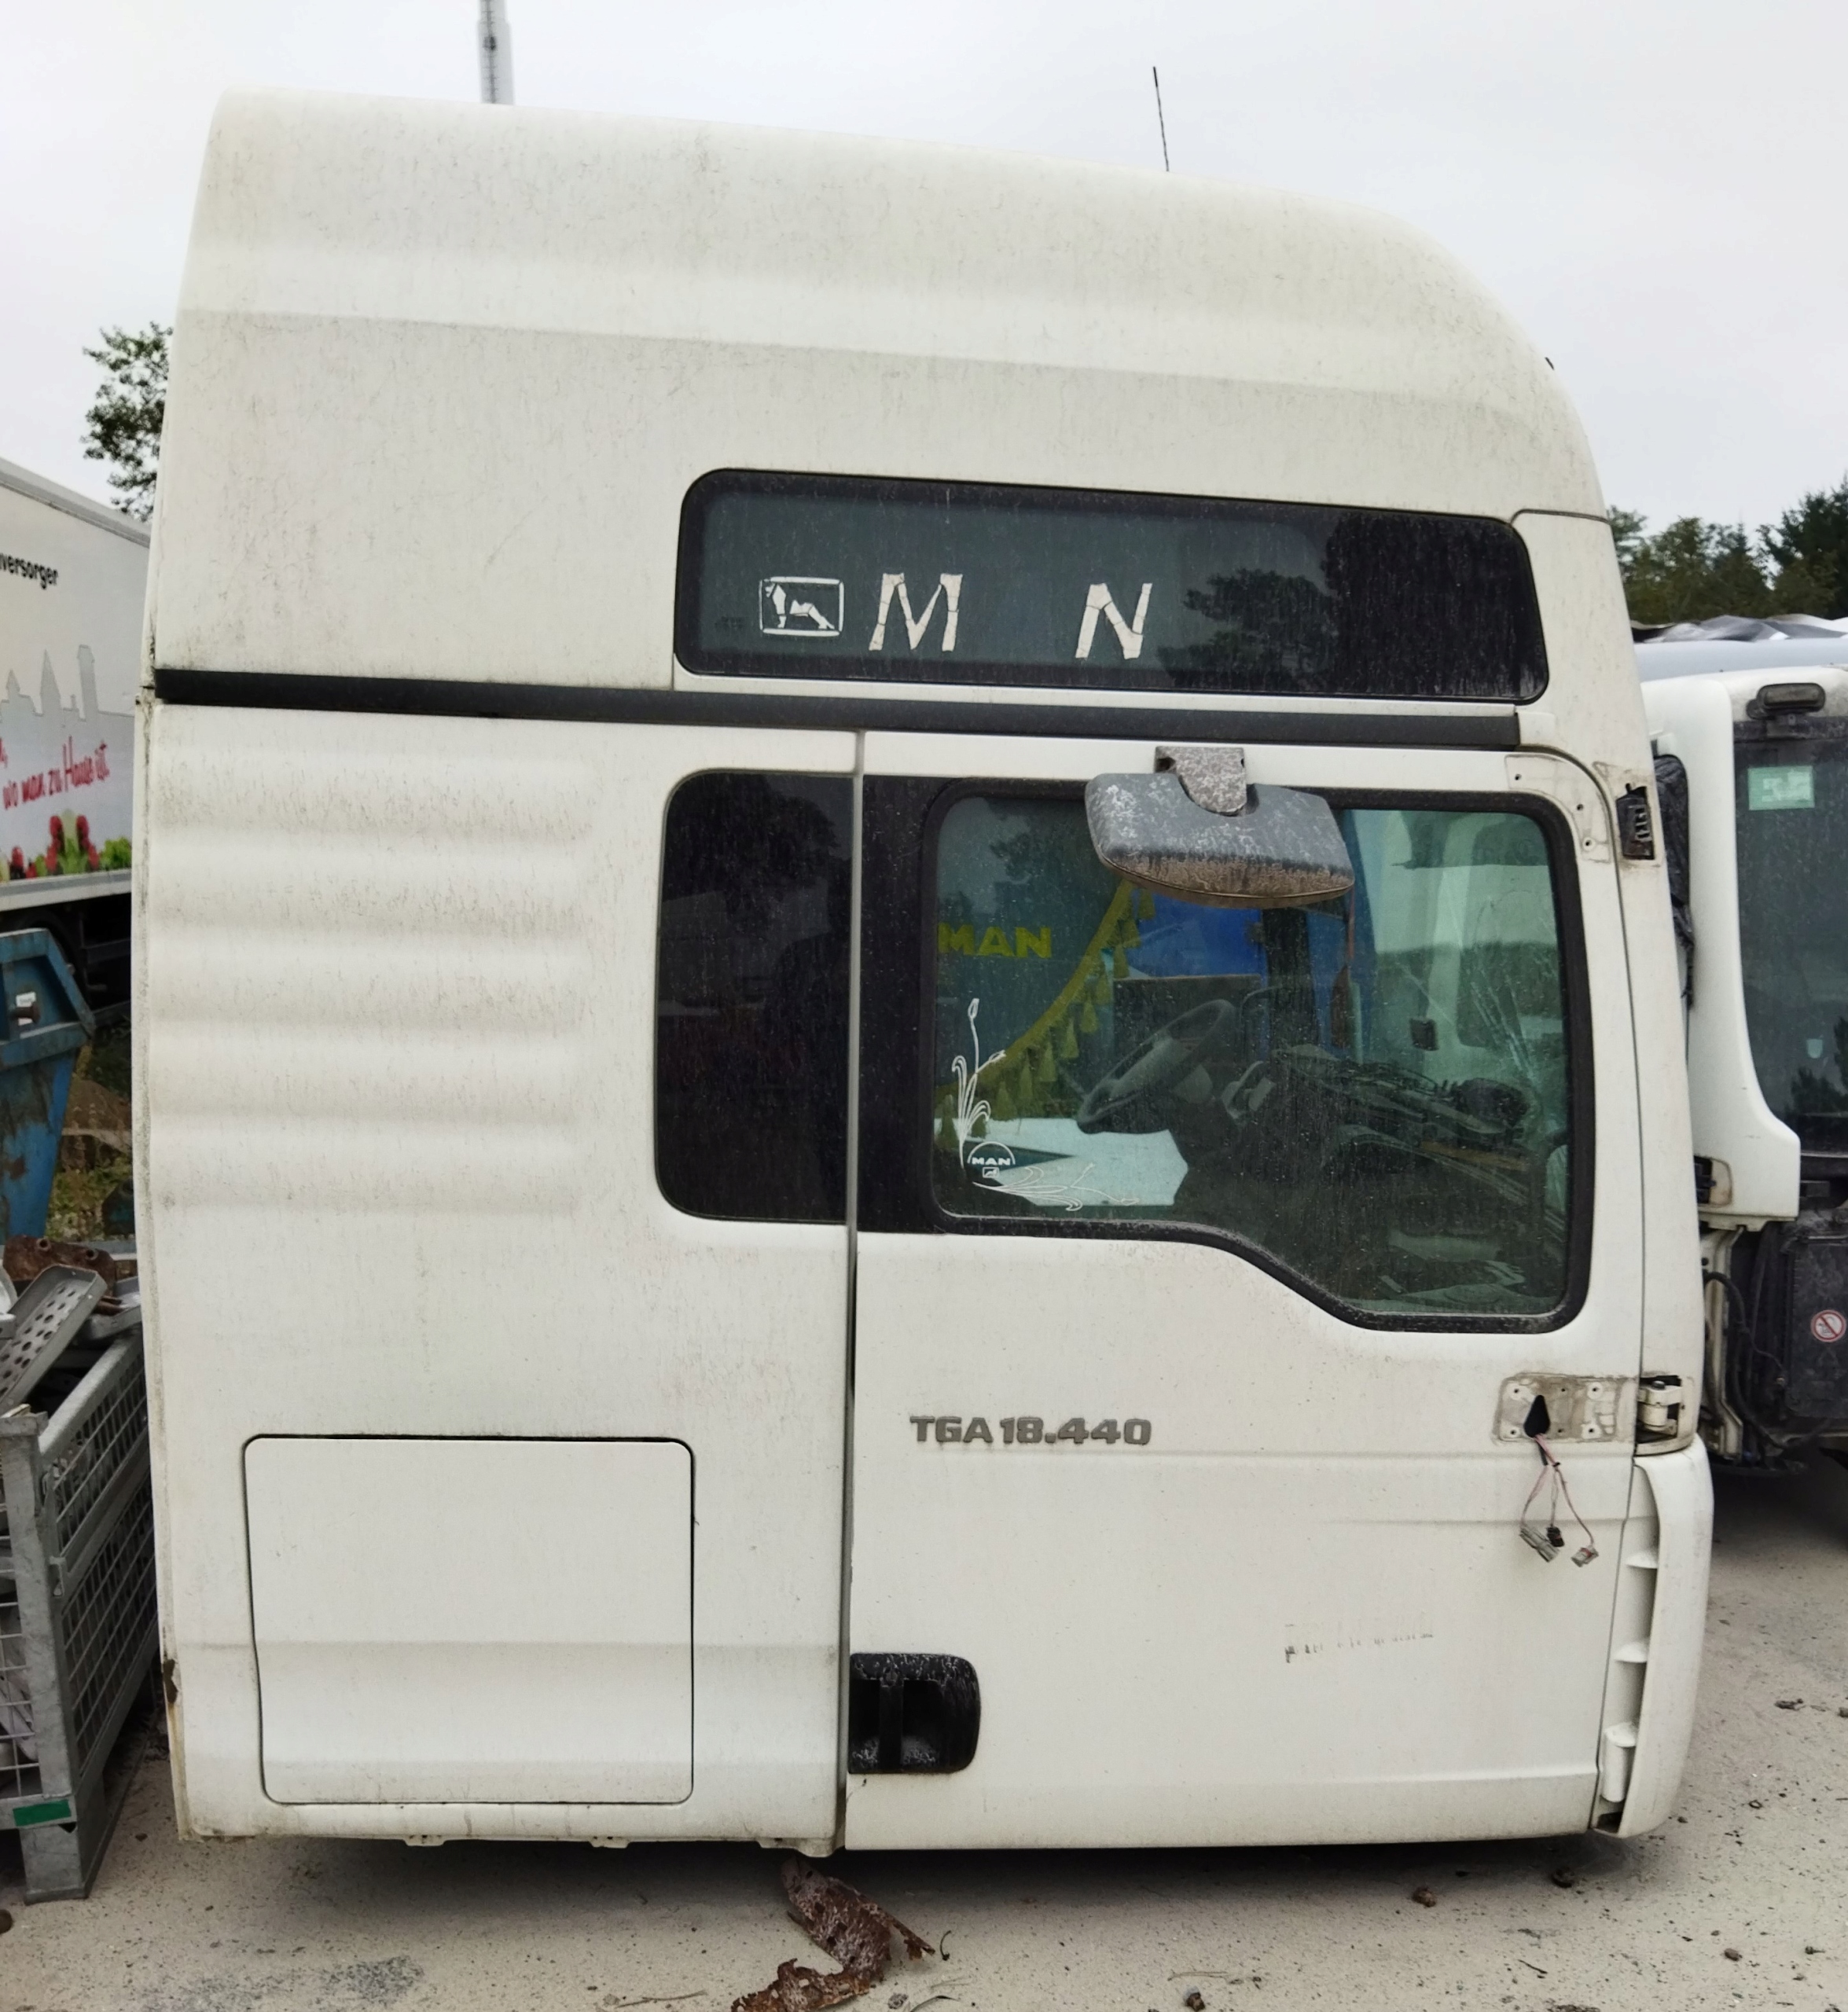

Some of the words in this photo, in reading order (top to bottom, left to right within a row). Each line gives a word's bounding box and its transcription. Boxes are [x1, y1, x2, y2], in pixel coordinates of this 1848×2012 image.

[0, 553, 58, 590] versorger
[938, 923, 1052, 958] MAN
[972, 1157, 1011, 1166] MAN
[909, 1416, 993, 1443] TGA
[1000, 1417, 1152, 1445] 18.440
